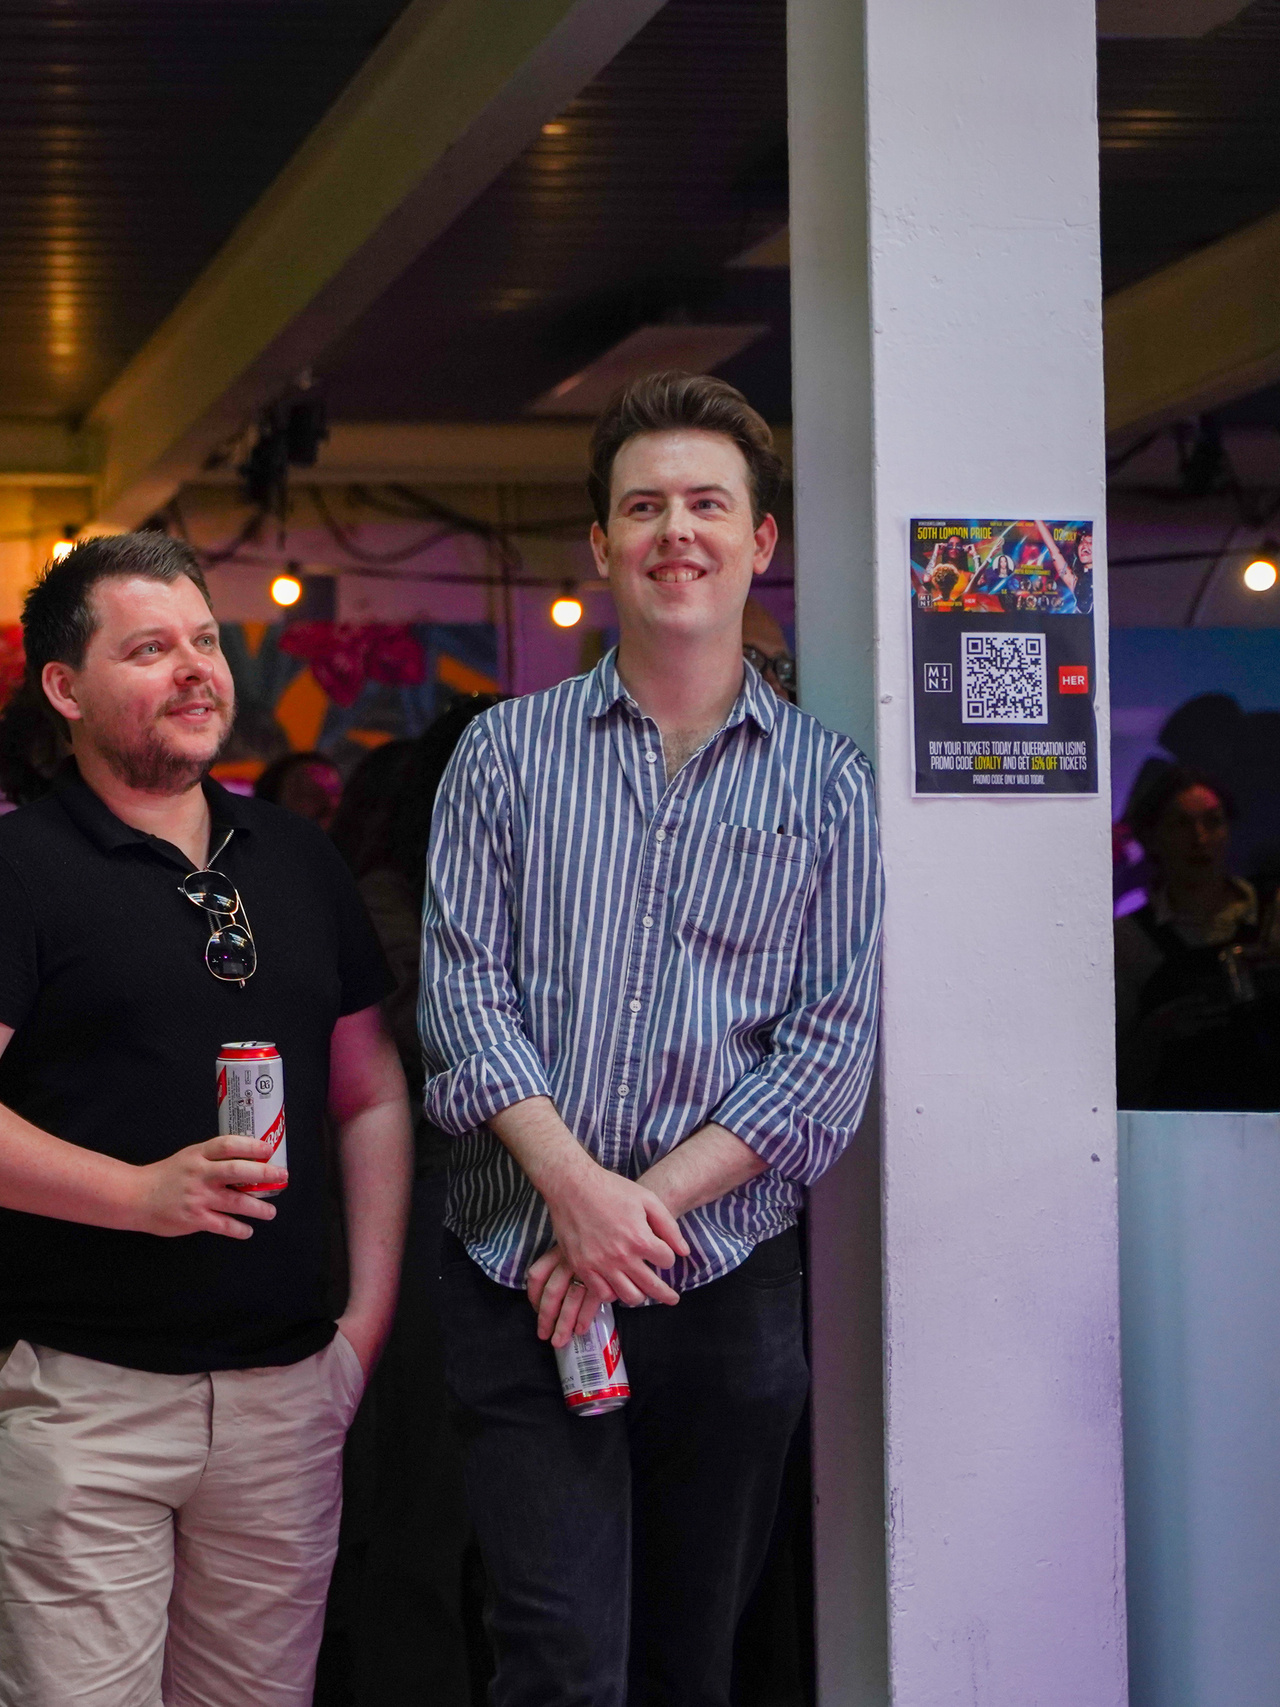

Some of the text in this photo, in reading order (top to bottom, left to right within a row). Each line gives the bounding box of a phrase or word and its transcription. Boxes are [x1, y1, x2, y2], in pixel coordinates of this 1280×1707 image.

[917, 527, 992, 540] 50TH LONDON PRIDE
[1062, 675, 1085, 686] HER
[929, 741, 1086, 756] BUY YOUR TICKETS TODAY AT QUEERCATION USING
[930, 756, 1087, 770] PROMO CODE LOYALTY AND GET 15% OFF TICKETS
[972, 774, 991, 785] PROMO
[991, 774, 1004, 785] CODE
[1004, 774, 1016, 785] ONLY
[1016, 774, 1030, 785] VALID
